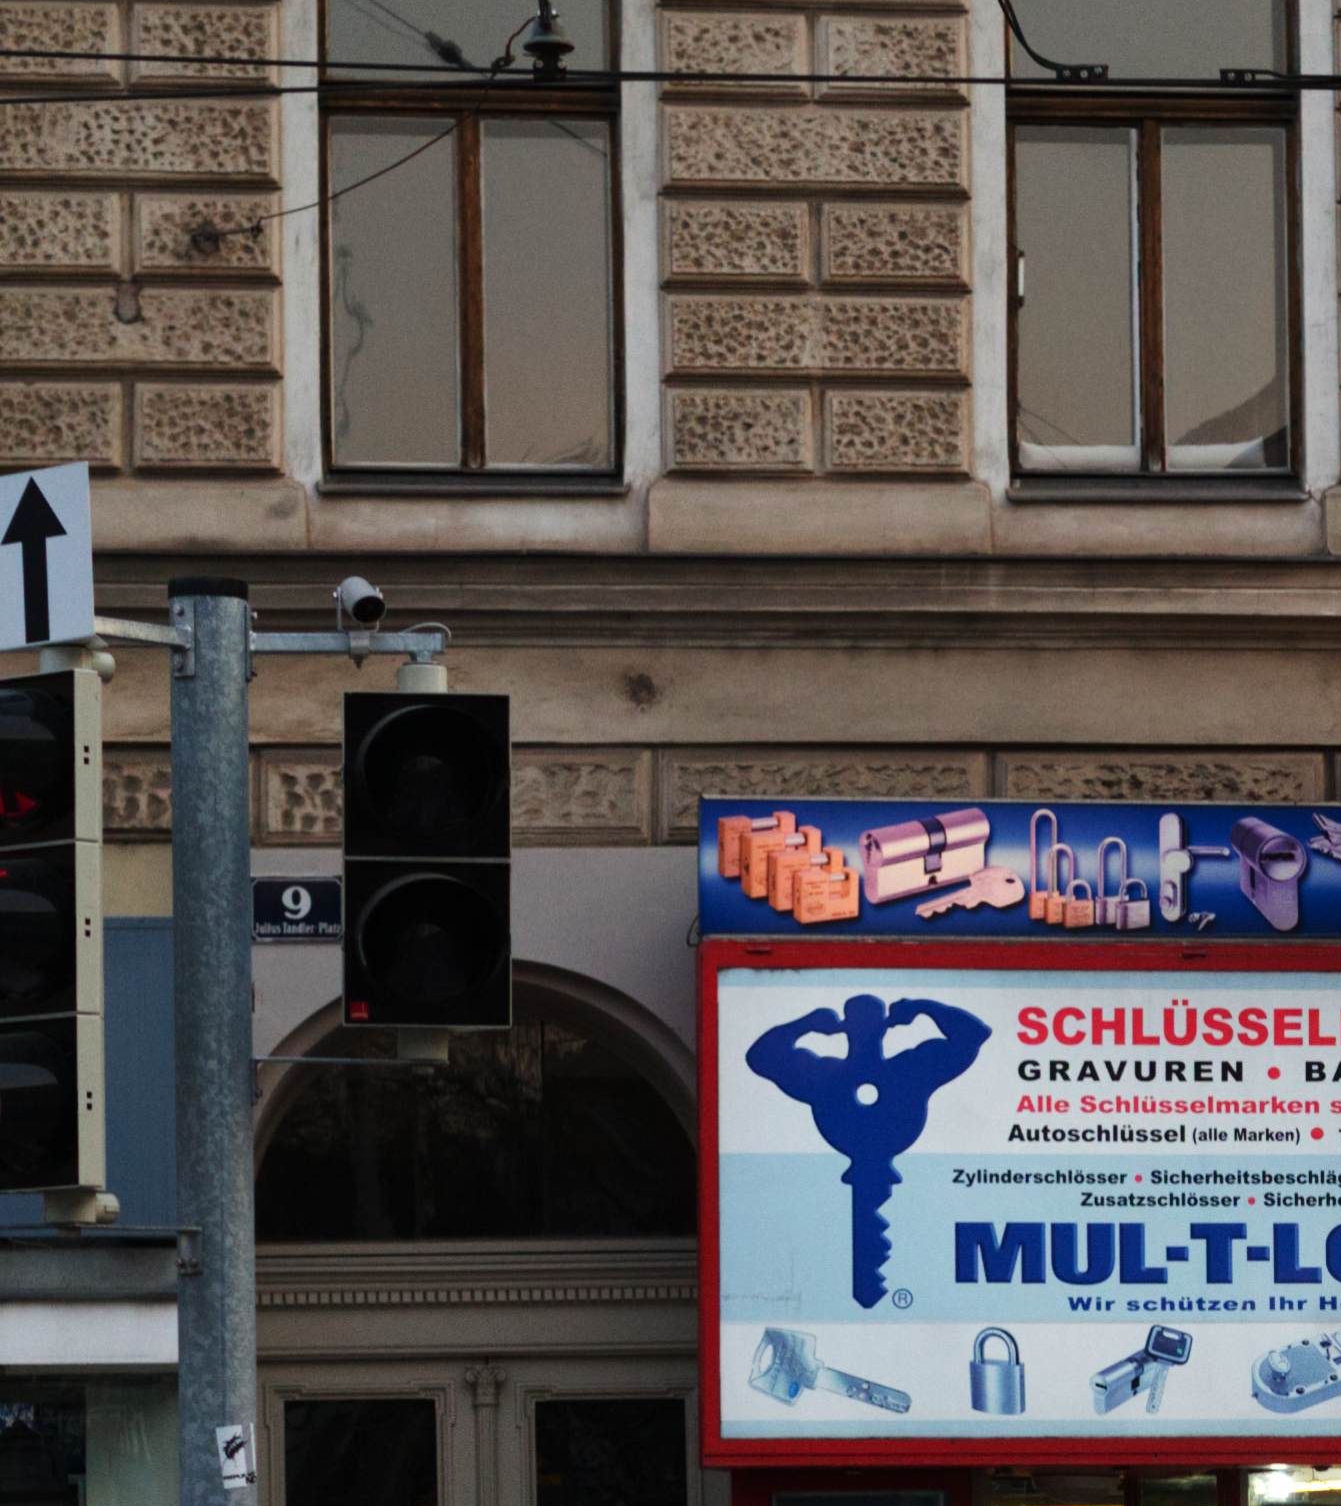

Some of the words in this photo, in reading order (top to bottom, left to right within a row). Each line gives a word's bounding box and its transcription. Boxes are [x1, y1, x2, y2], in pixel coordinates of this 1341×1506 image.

[281, 885, 313, 920] 9
[1017, 1060, 1245, 1083] GRAVUREN
[1016, 1095, 1070, 1115] Alle
[1079, 1095, 1321, 1115] Schlüsselmarken
[1007, 1124, 1187, 1143] Autoschlüssel
[1192, 1126, 1228, 1145] (alle
[1233, 1126, 1301, 1145] Marken)
[951, 1169, 1128, 1187] Zylinderschlösser
[1080, 1191, 1241, 1208] Zusatzschlösser
[1068, 1296, 1116, 1312] Wir
[1126, 1295, 1257, 1312] schützen
[1268, 1296, 1308, 1311] Ihr
